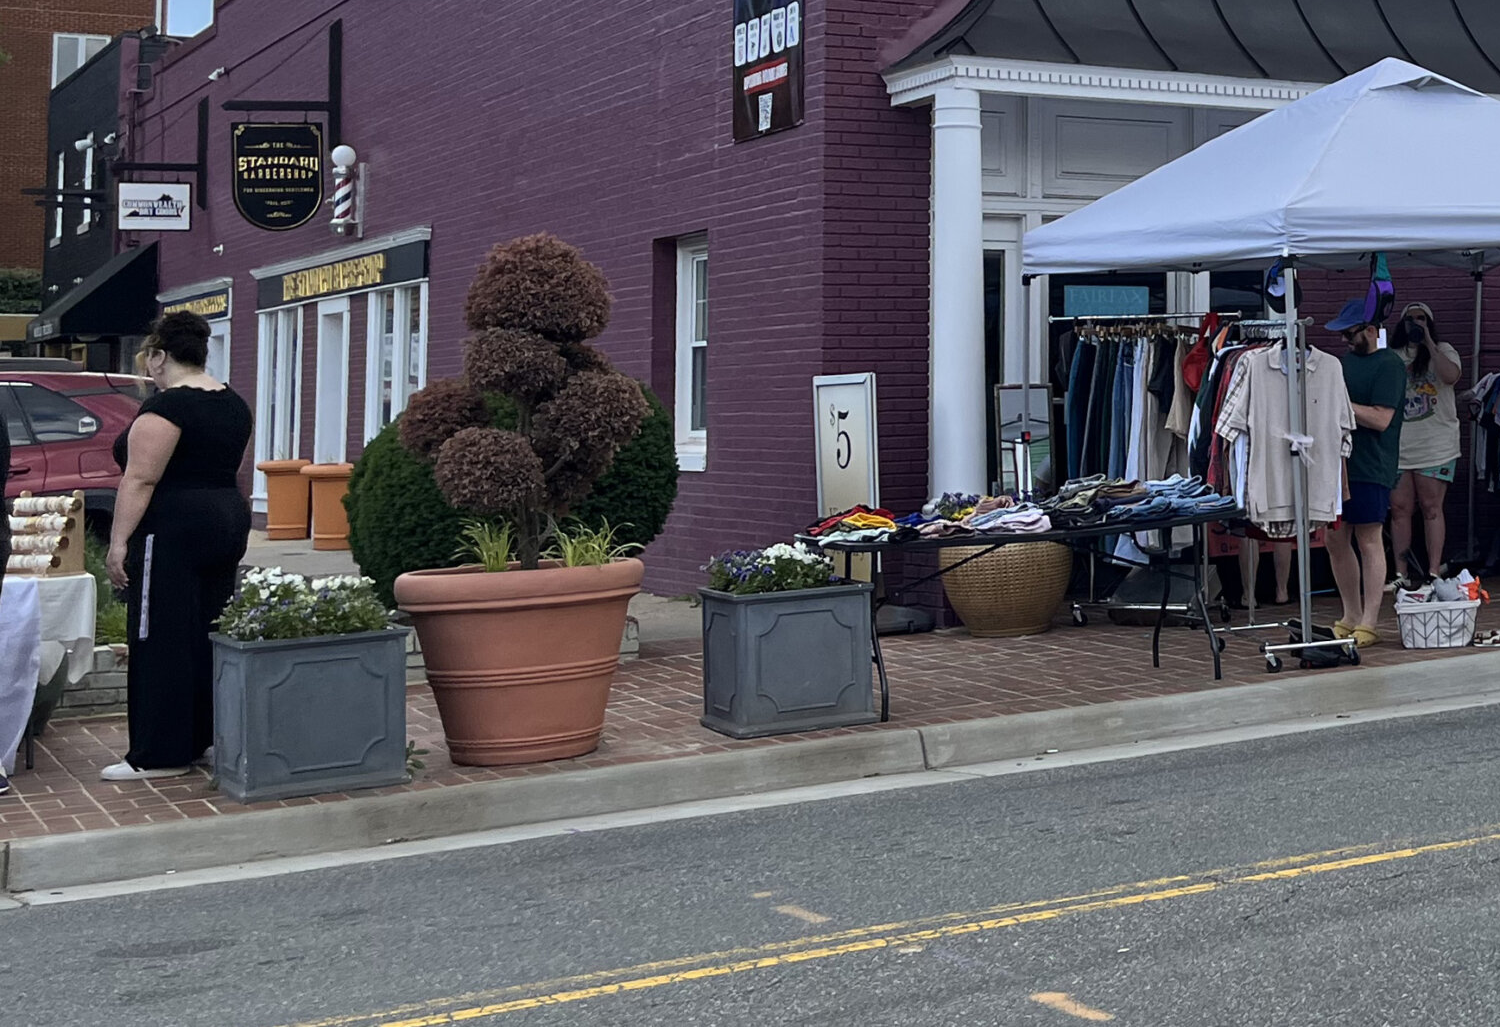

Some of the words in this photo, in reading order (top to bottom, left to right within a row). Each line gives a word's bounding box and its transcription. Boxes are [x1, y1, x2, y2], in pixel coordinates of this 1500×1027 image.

[238, 156, 319, 172] STANDARD
[243, 168, 314, 180] BARBERSHOP
[1069, 288, 1143, 304] FAIRFAX
